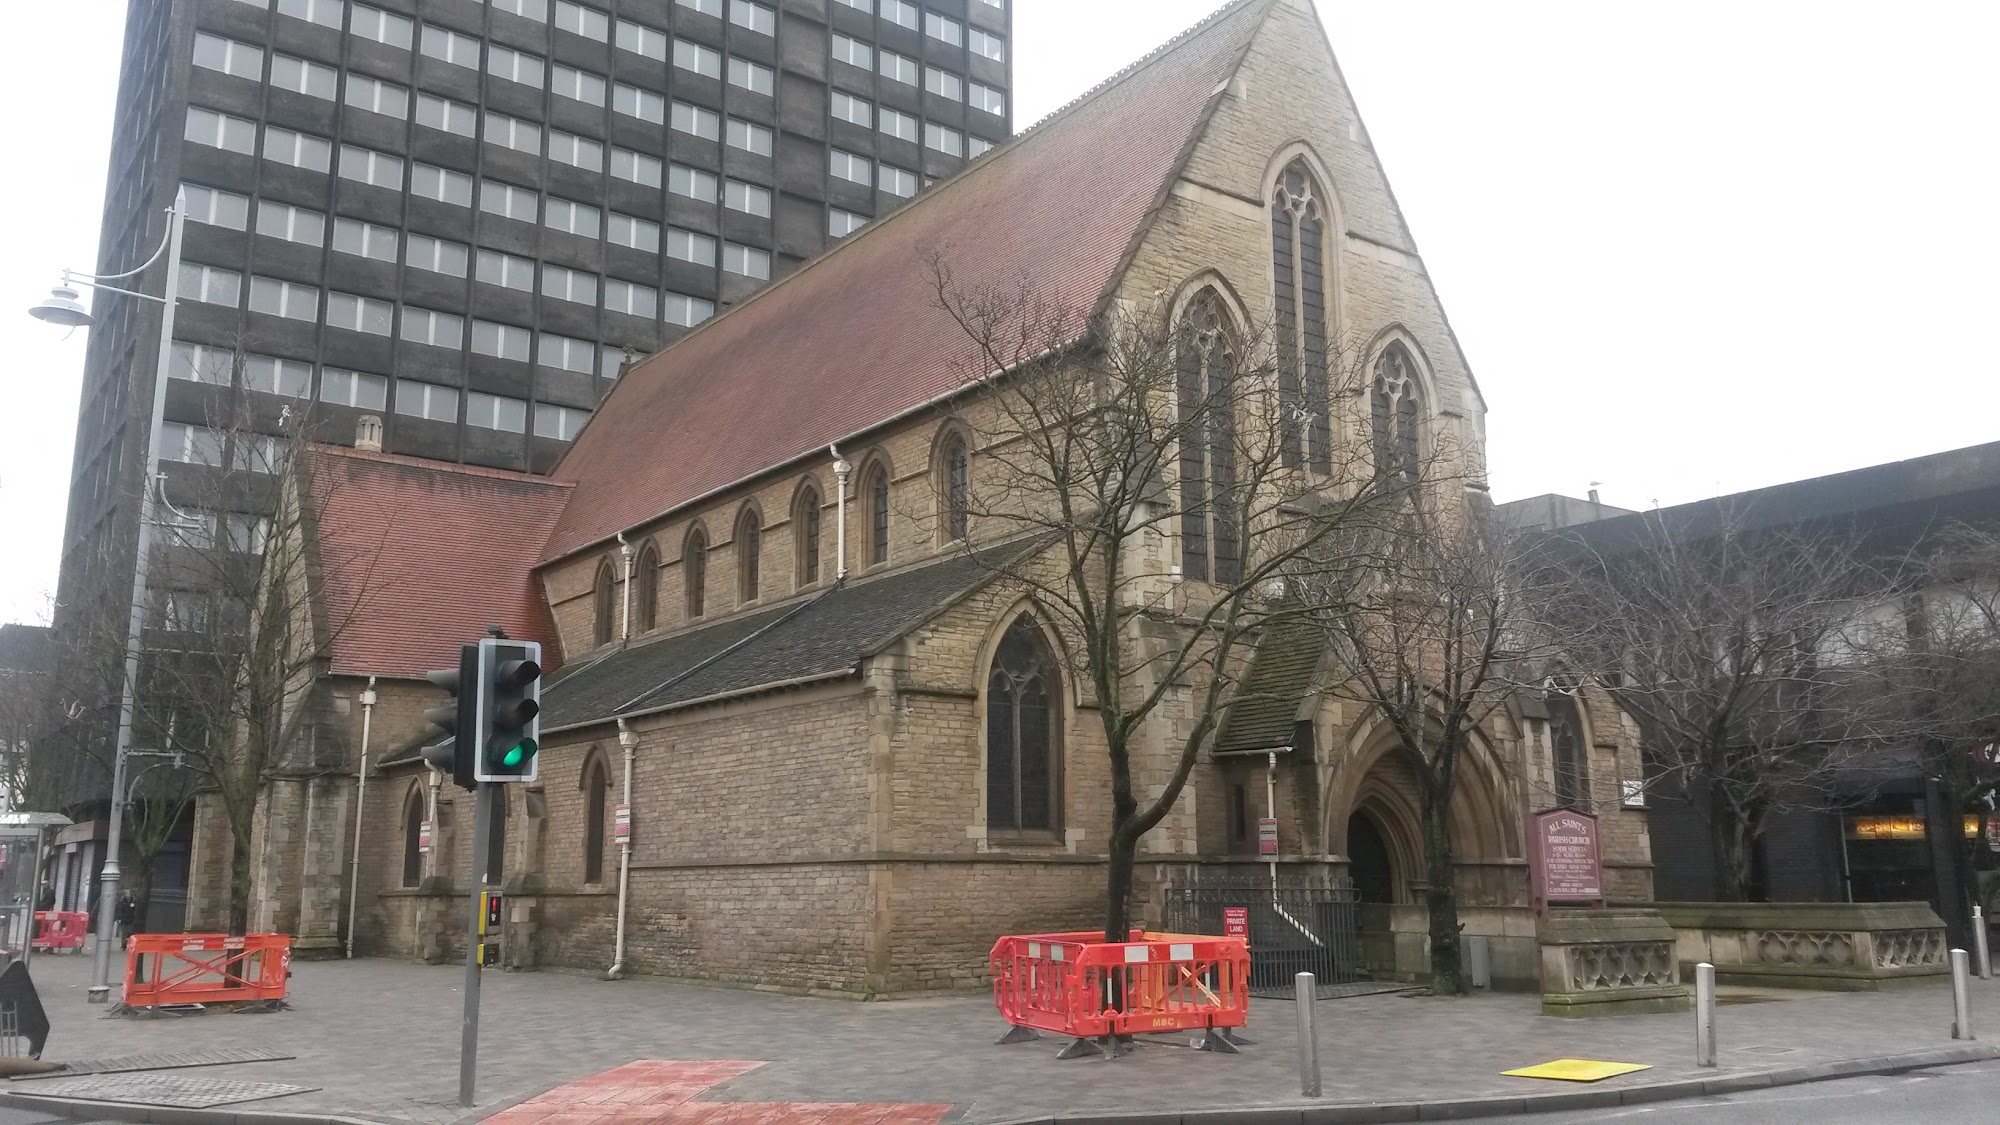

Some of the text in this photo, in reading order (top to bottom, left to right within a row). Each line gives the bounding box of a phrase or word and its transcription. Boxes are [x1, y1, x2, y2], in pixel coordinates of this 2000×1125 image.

[1549, 819, 1587, 834] ALL SAINTS
[1548, 836, 1590, 845] PARISH CHURCH
[1152, 1017, 1174, 1027] MBC
